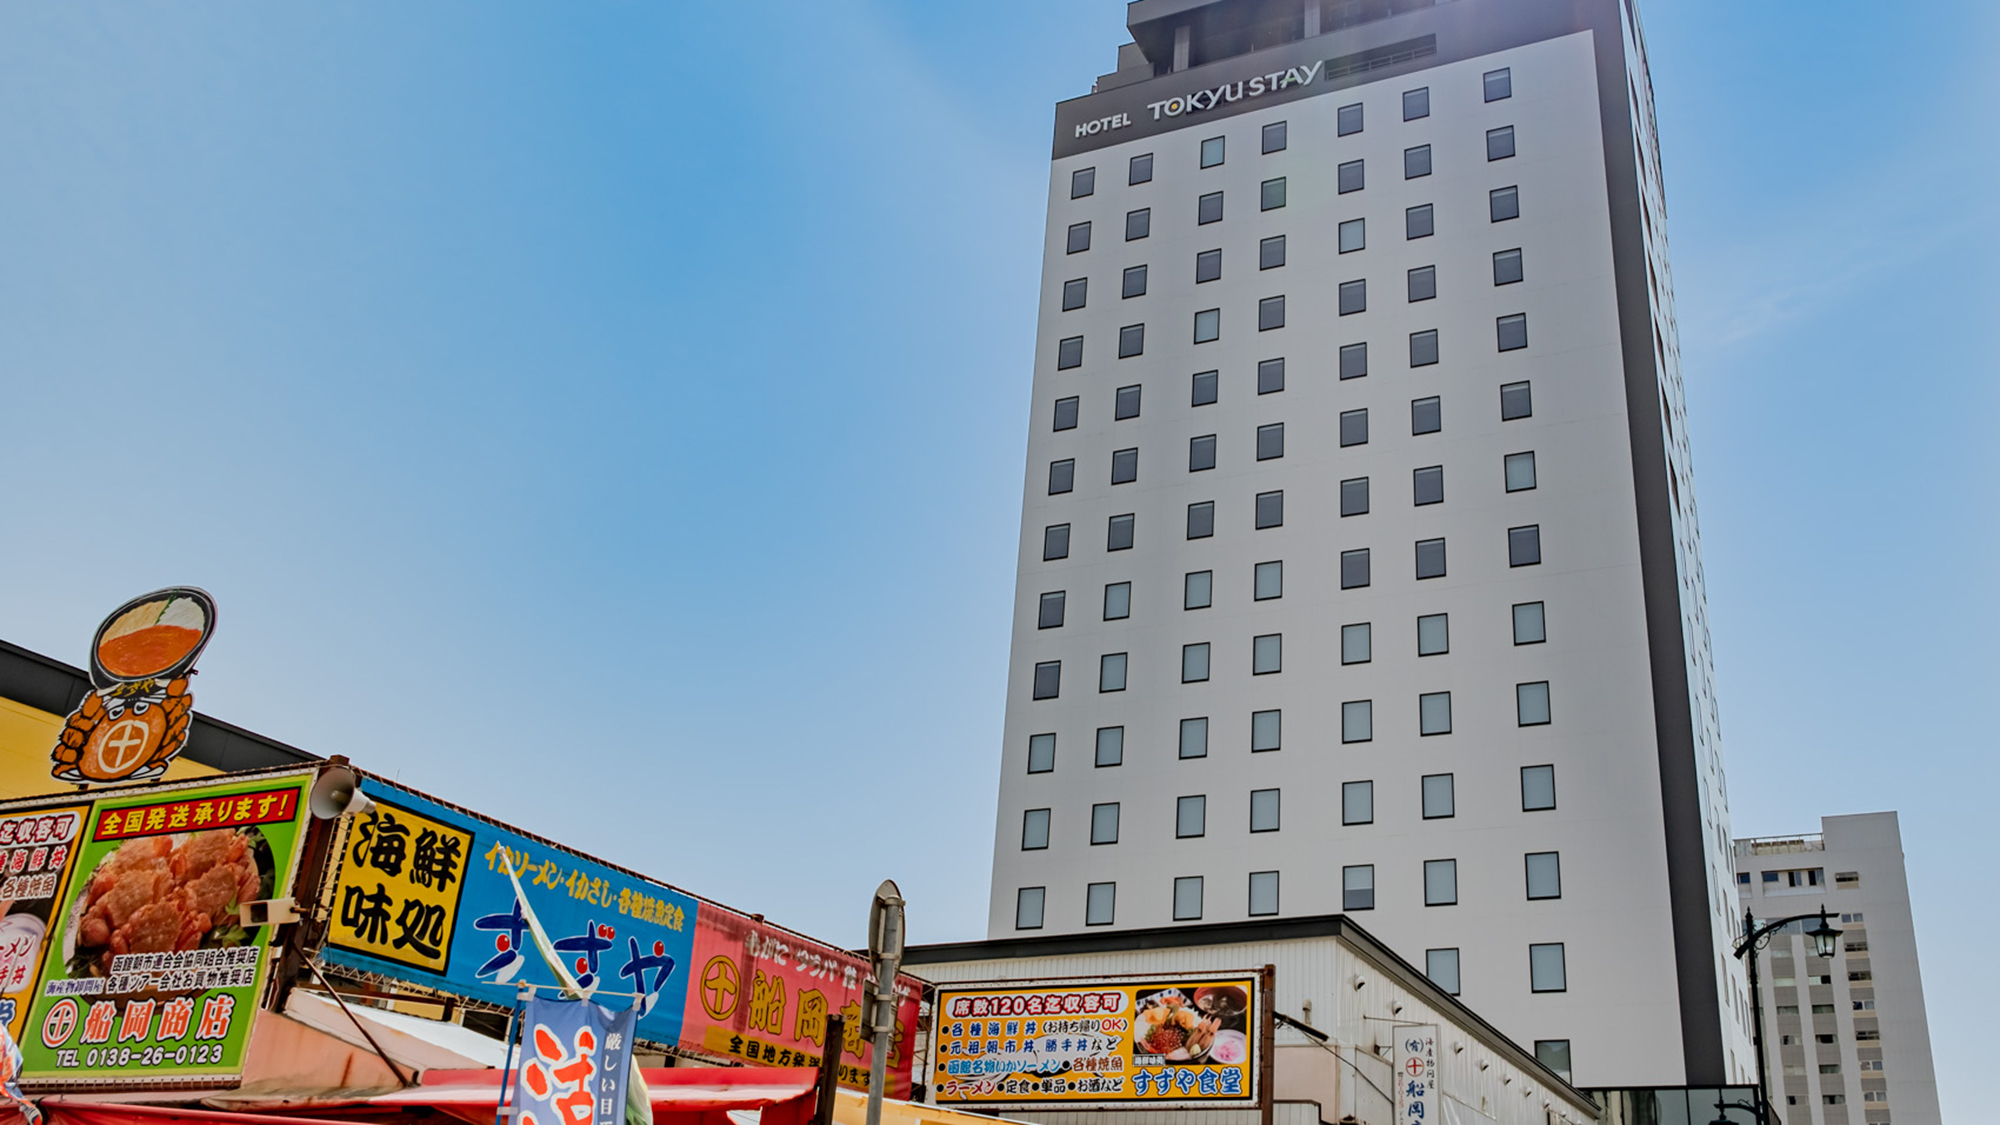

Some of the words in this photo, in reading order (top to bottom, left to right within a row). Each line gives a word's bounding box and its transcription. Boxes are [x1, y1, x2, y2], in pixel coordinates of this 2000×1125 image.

[1075, 112, 1131, 138] HOTEL
[1147, 81, 1243, 120] TOKYU
[1249, 60, 1323, 97] STAY
[352, 810, 461, 892] 海鮮
[341, 882, 446, 960] 味処
[80, 994, 236, 1044] 船岡商店
[953, 992, 1121, 1017] 席数120名迄収容可
[56, 1050, 80, 1067] TEL
[86, 1045, 223, 1067] 0138-26-0123
[945, 1081, 996, 1095] ラーメン
[1005, 1080, 1031, 1094] 定食
[1132, 1066, 1242, 1095] すずや食堂
[1406, 1080, 1425, 1125] 船岡
